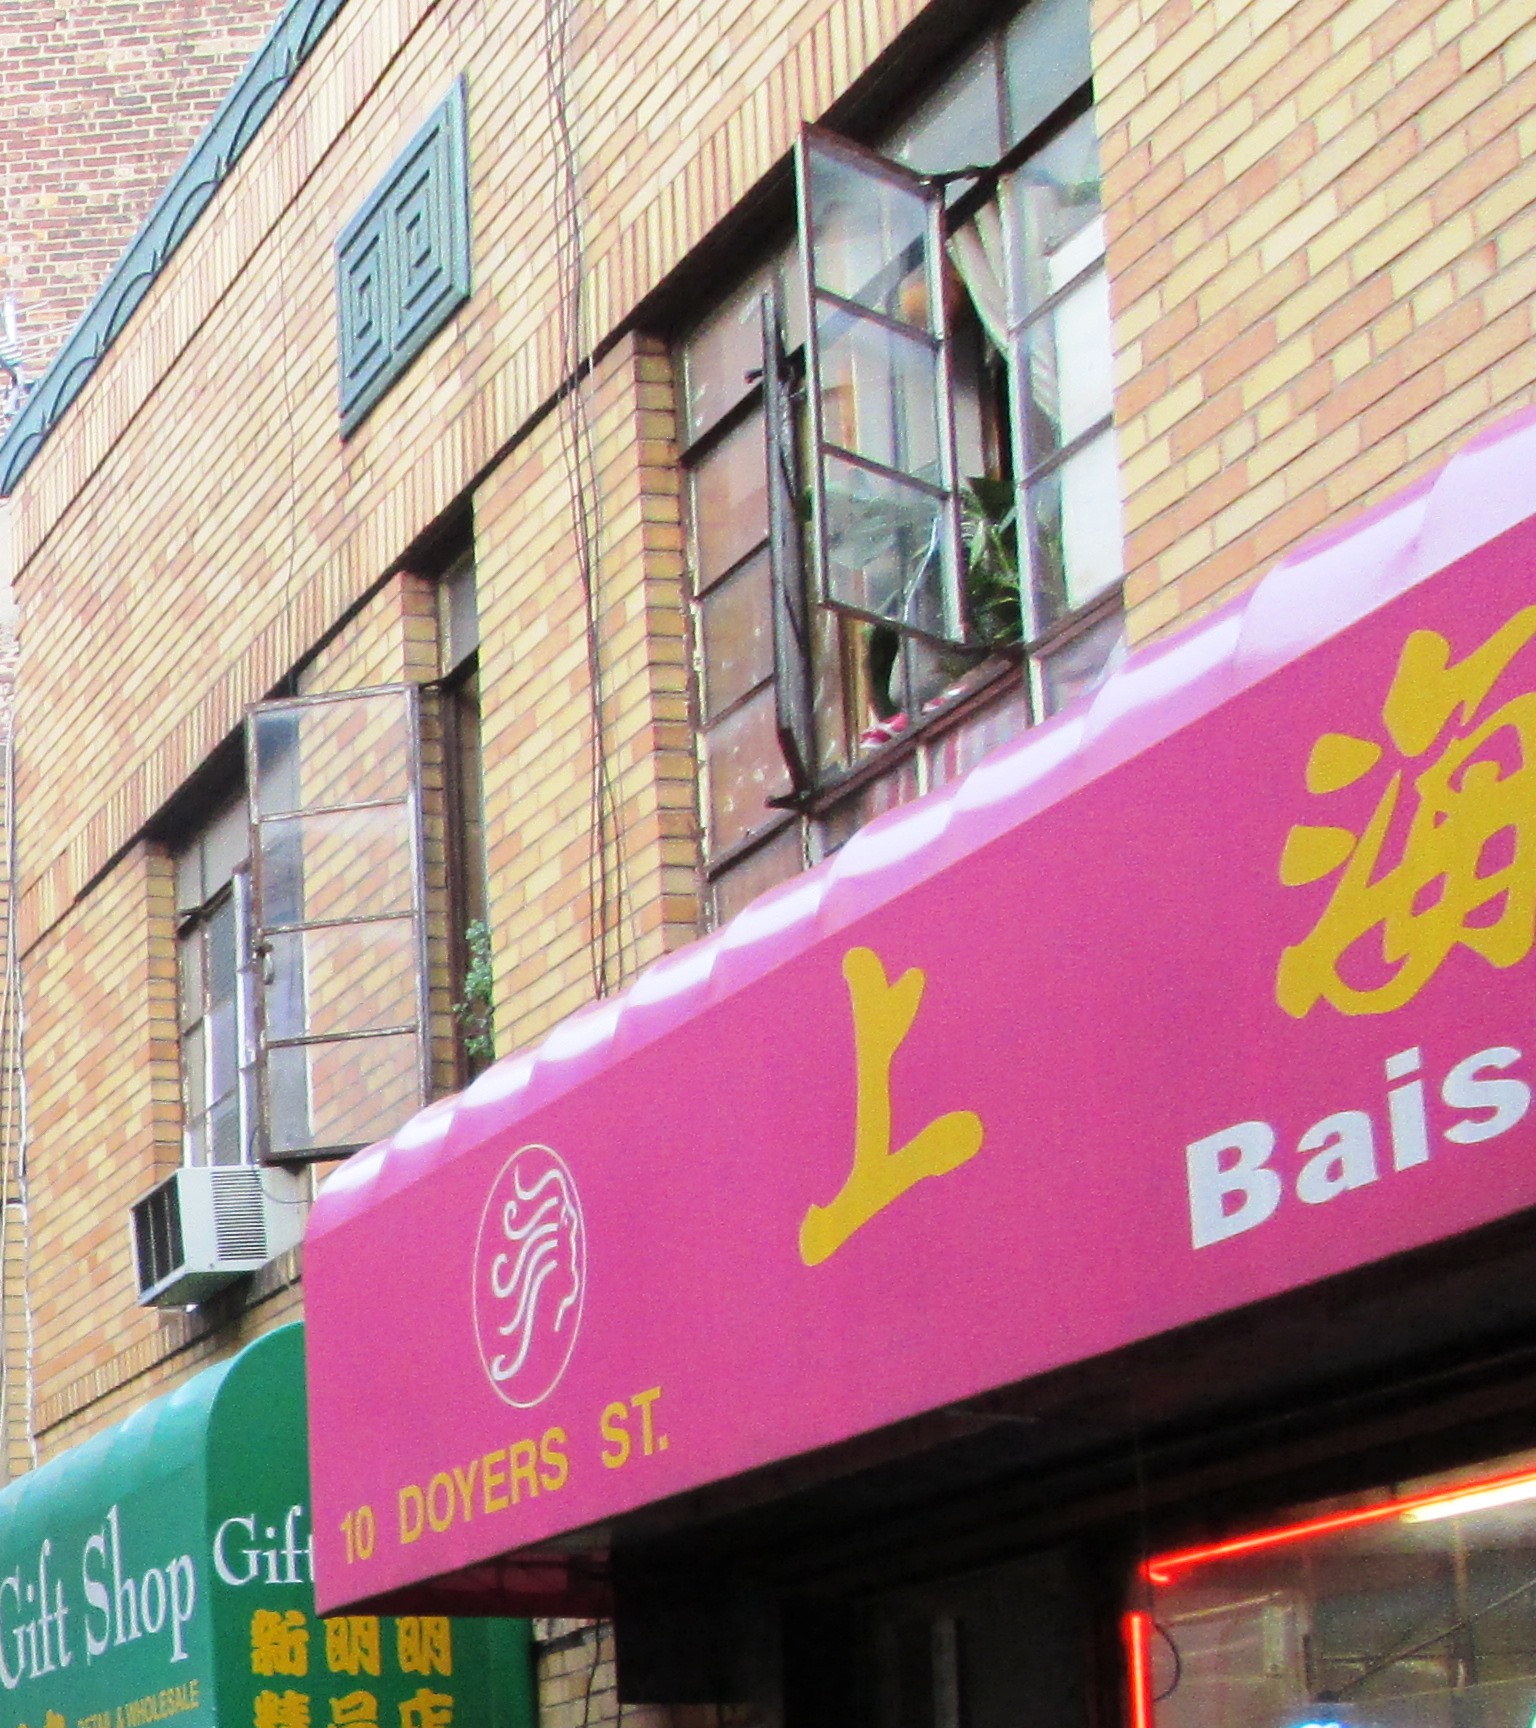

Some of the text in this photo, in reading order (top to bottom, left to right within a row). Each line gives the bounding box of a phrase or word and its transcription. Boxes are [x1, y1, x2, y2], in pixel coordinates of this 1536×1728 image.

[339, 1386, 670, 1565] 10 DOYERS ST.
[83, 1505, 196, 1663] Shop
